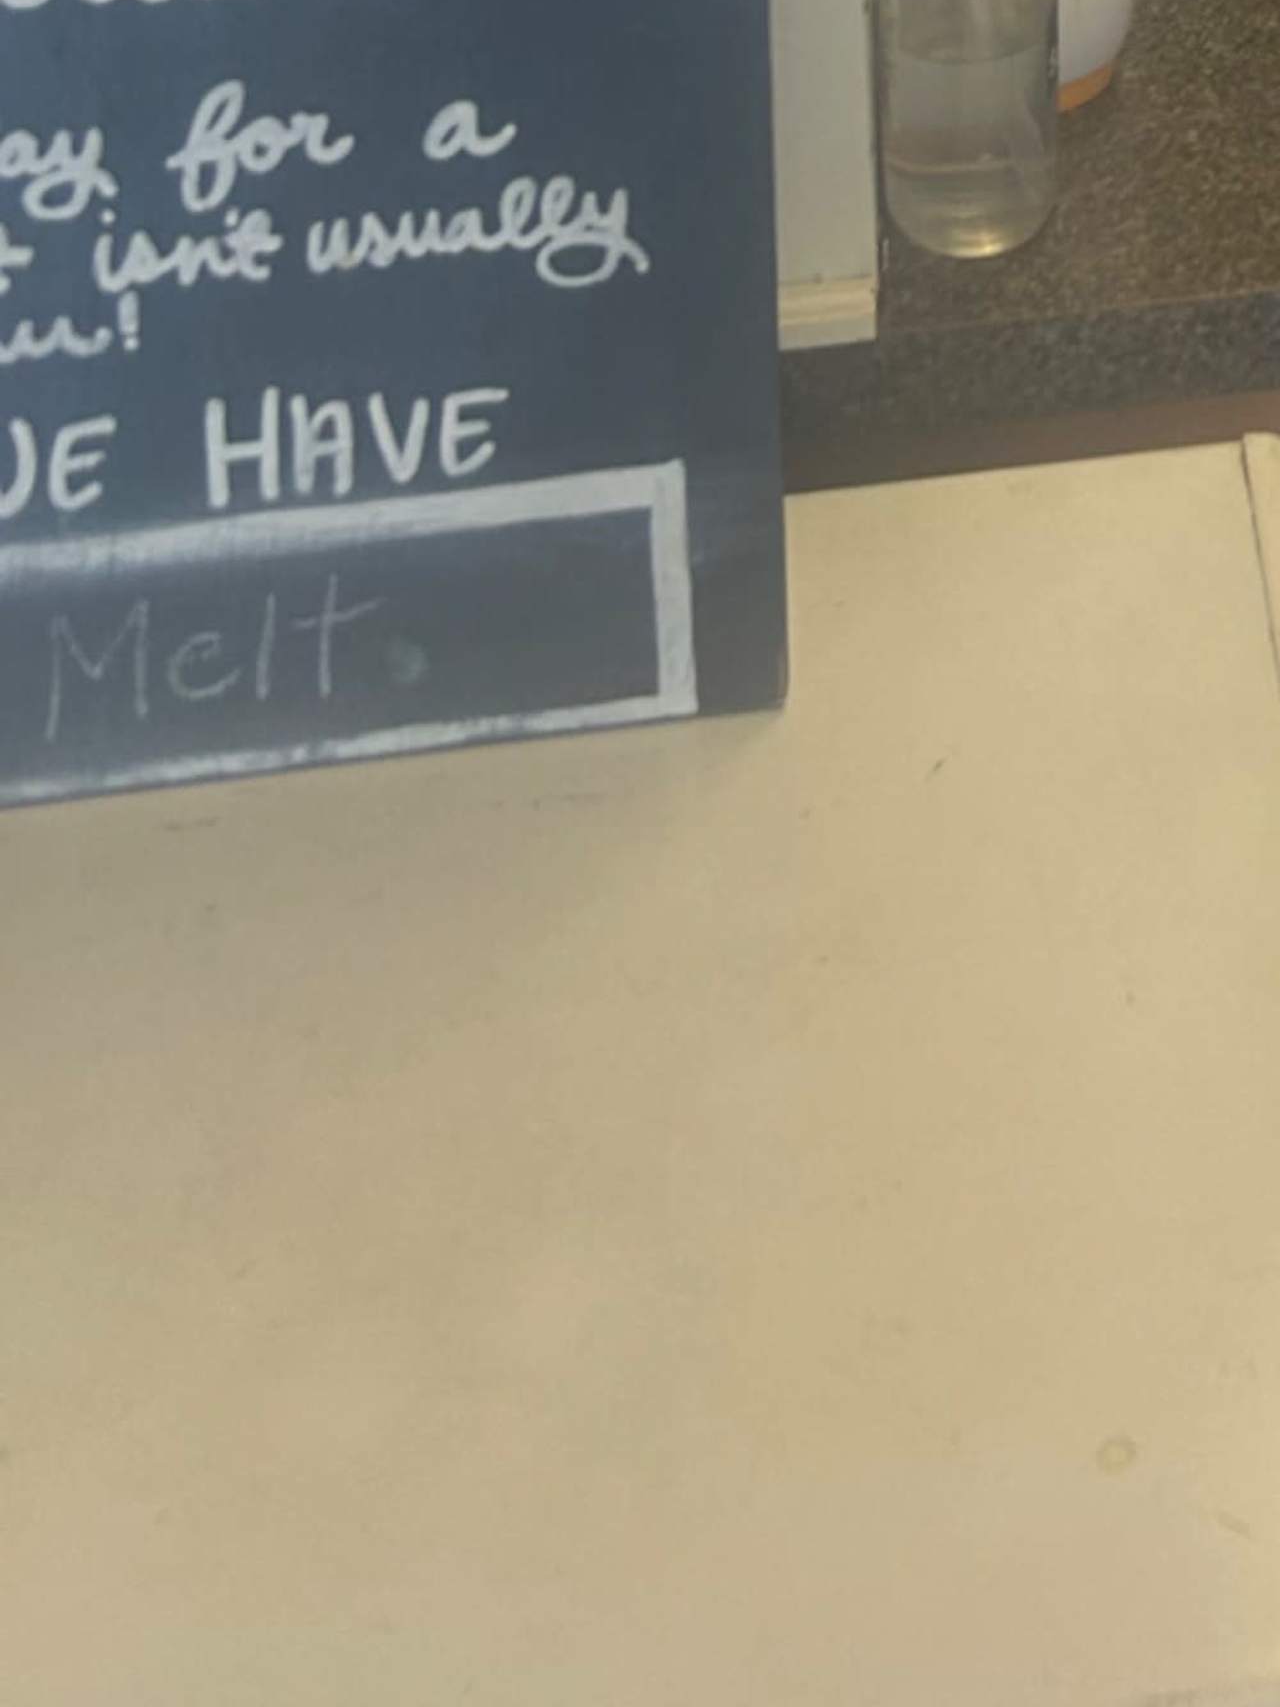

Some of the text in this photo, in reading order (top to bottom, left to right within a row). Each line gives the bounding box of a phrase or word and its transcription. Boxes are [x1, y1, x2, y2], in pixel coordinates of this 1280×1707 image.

[167, 81, 354, 212] for
[423, 100, 517, 160] a
[94, 207, 284, 293] isn't
[306, 174, 650, 287] usually
[204, 386, 510, 510] HAVE
